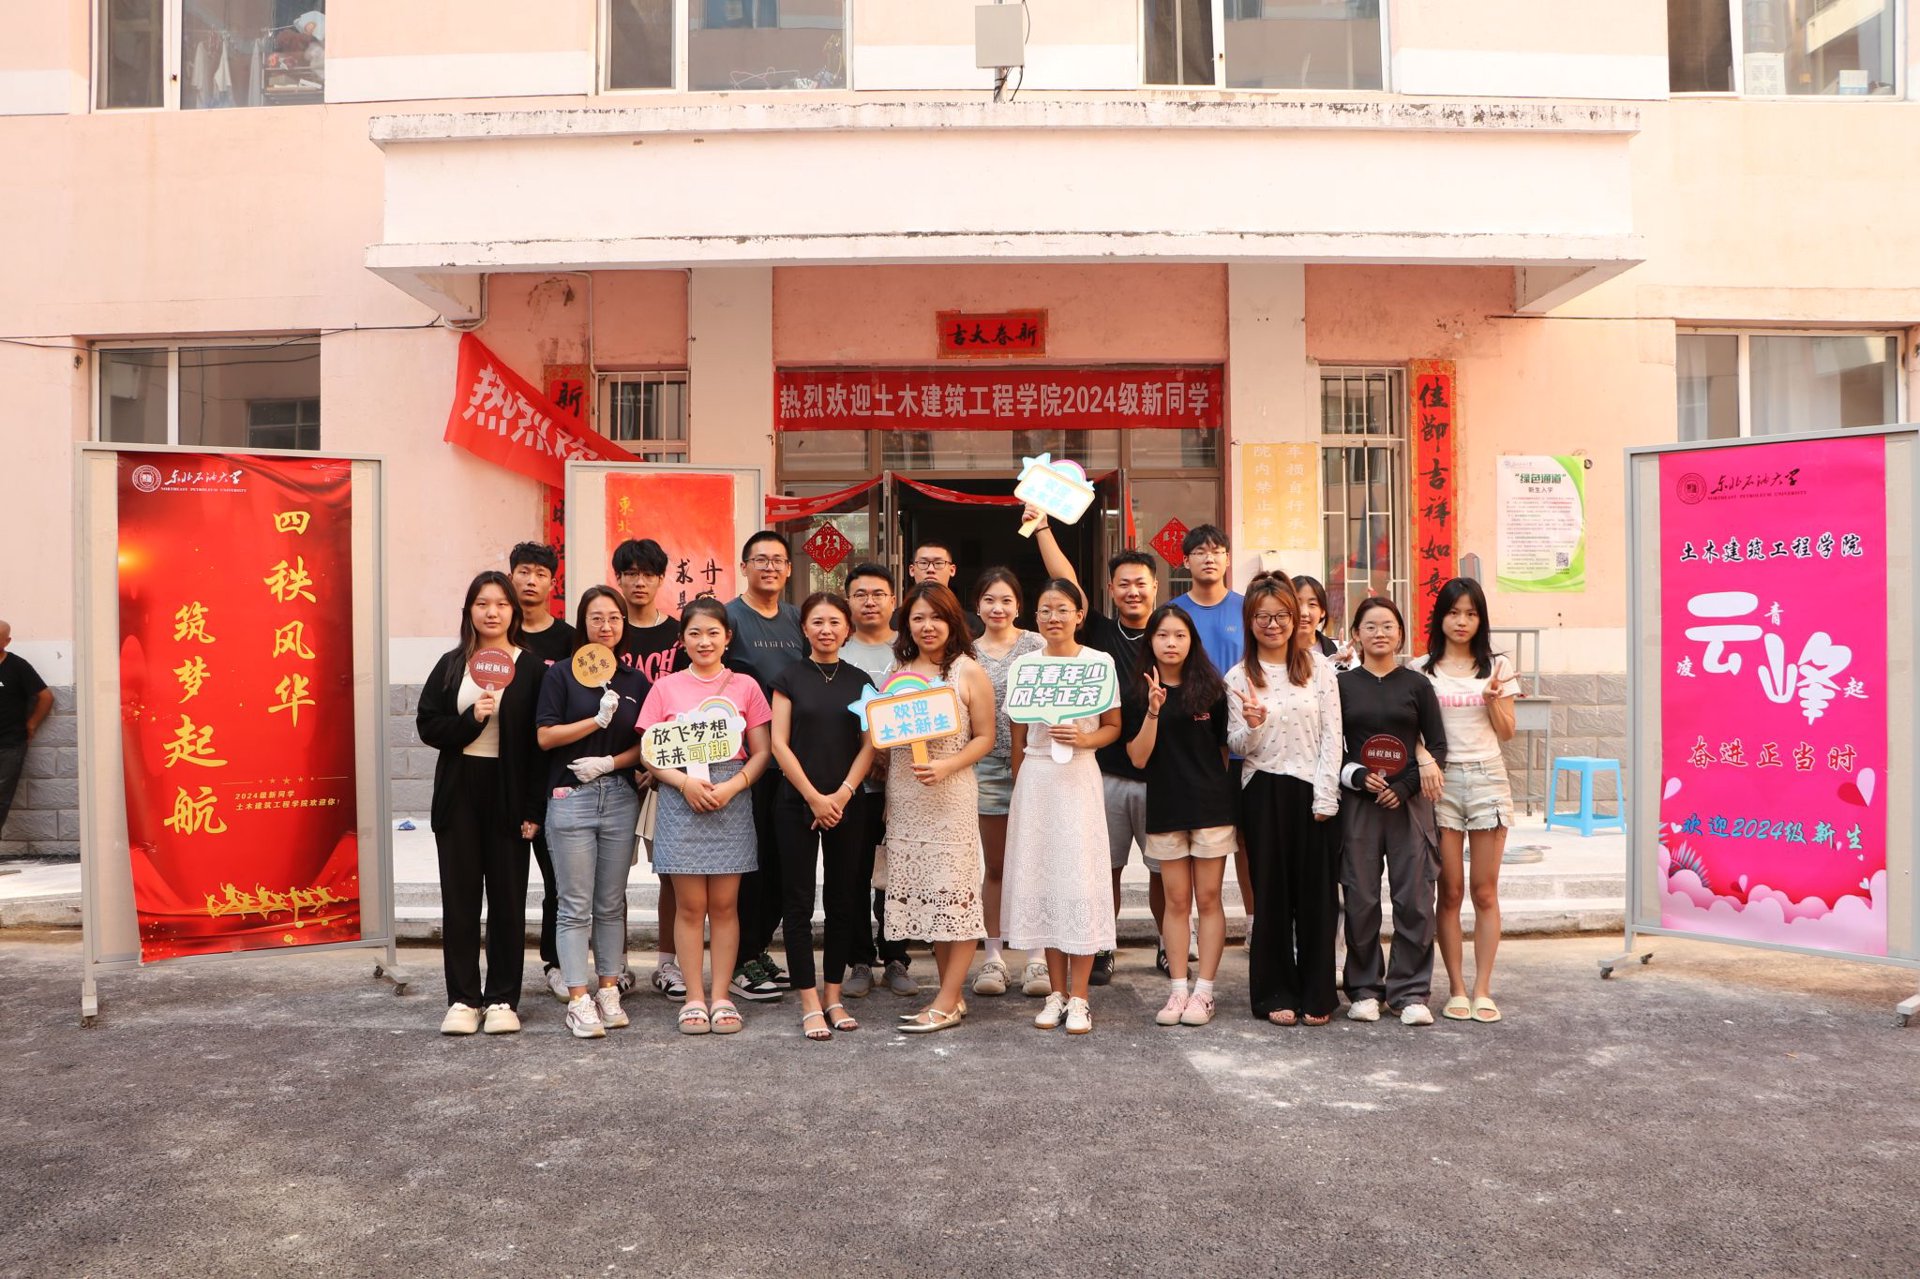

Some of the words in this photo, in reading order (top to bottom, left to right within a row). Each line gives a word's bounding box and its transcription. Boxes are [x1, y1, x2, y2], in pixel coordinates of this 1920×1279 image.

[779, 382, 1209, 419] 热烈欢迎土木建筑工程学院2024级新同学
[1680, 531, 1863, 562] 土木建筑工程学院
[263, 510, 316, 728] 四秩风华
[1017, 663, 1107, 685] 青春年少
[893, 699, 929, 720] 欢迎
[1009, 685, 1102, 707] 风华正茂
[163, 601, 228, 835] 筑梦起航
[652, 719, 728, 745] 放飞梦想
[880, 713, 951, 740] 土木新生
[656, 740, 731, 767] 未来可期
[1687, 735, 1857, 772] 奋进正当时
[1682, 813, 1864, 850] 欢迎2024级新生
